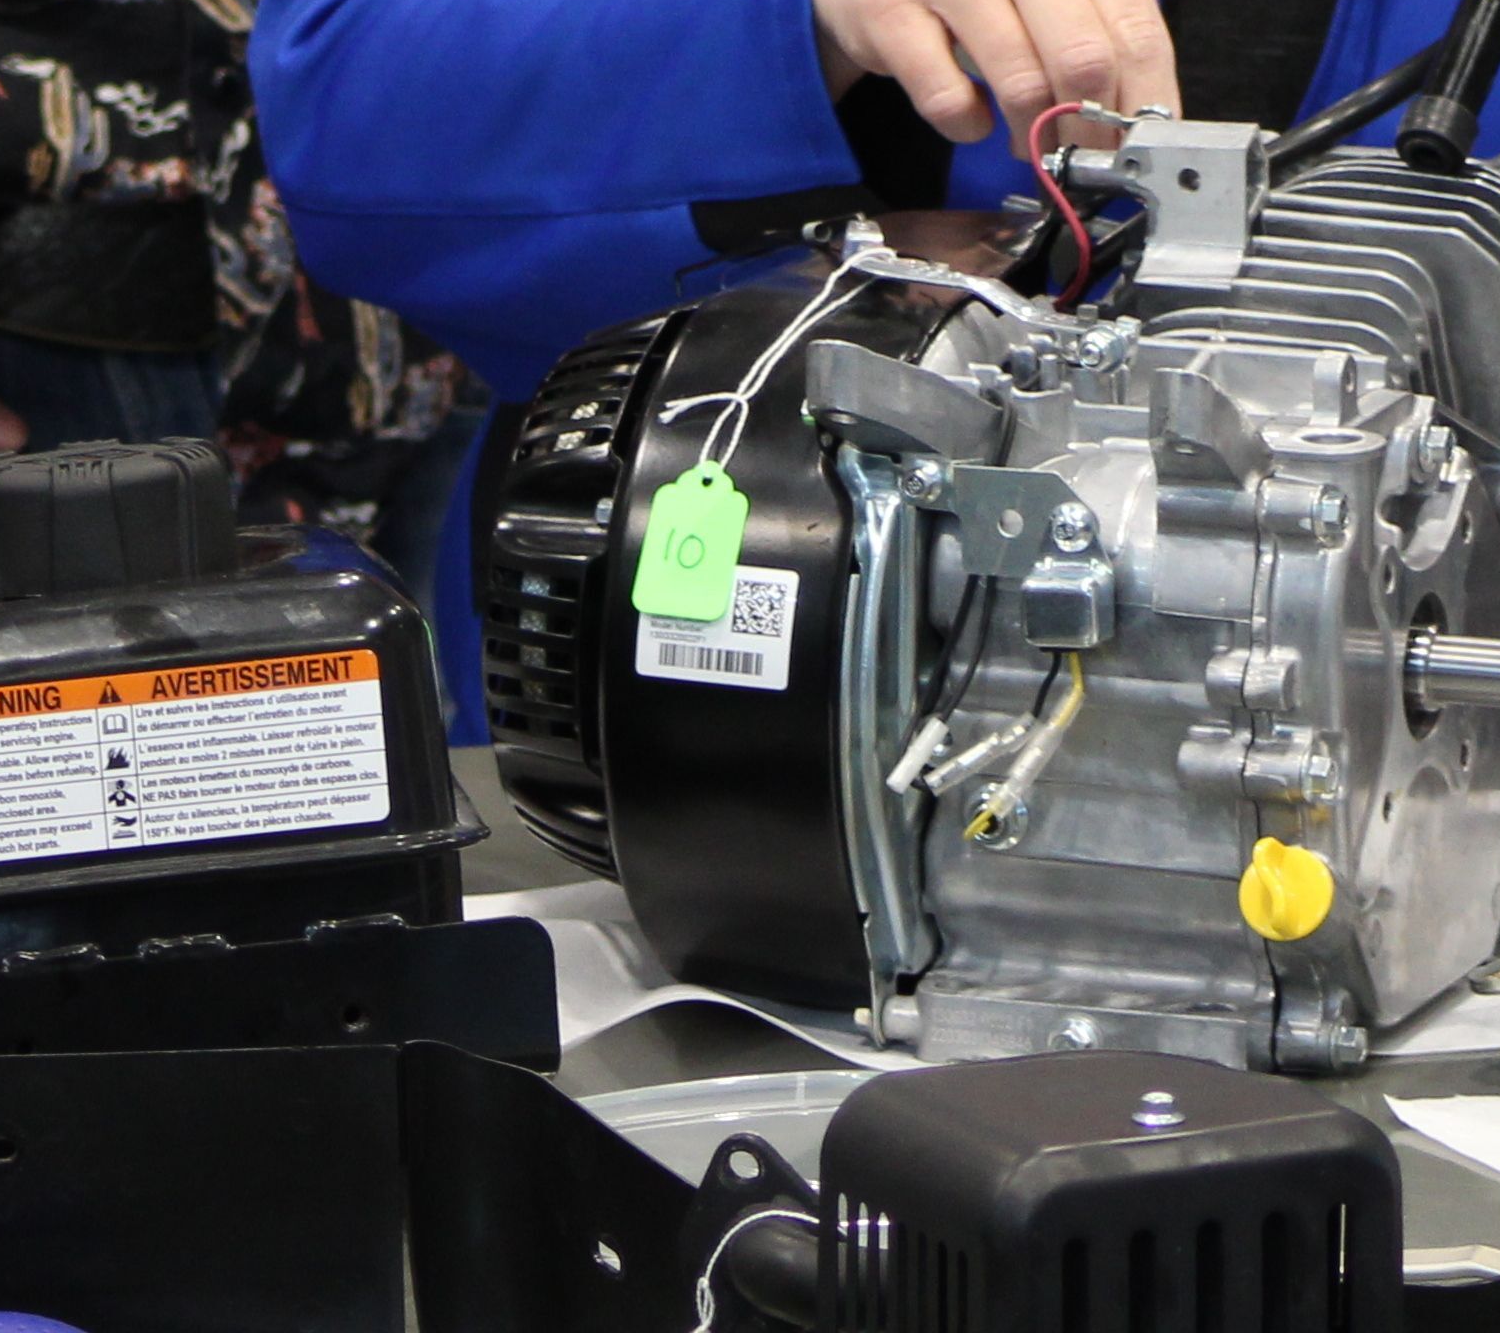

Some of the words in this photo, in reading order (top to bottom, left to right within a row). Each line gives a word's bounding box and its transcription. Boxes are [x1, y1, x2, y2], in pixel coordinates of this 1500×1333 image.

[664, 528, 705, 569] 10
[151, 656, 353, 699] AVERTISSEMENT
[136, 708, 152, 717] Lire
[155, 706, 164, 716] et
[166, 704, 193, 714] suivre
[196, 703, 209, 711] les
[212, 698, 264, 710] instructions
[322, 688, 346, 699] avant
[138, 723, 148, 732] de
[207, 714, 246, 725] effectuer
[297, 707, 307, 716] du
[1, 735, 41, 747] servicing
[187, 739, 200, 748] est
[262, 731, 294, 741] Laisser
[297, 726, 332, 738] refroidir
[335, 725, 342, 734] le
[345, 723, 376, 733] moteur
[26, 755, 49, 765] Allow
[53, 752, 82, 763] engine
[85, 750, 93, 759] to
[140, 756, 176, 770] pendant
[179, 756, 189, 764] au
[192, 752, 219, 762] moins
[222, 751, 227, 759] 2
[230, 748, 265, 759] minutes
[268, 744, 292, 755] avant
[295, 743, 305, 752] de
[308, 742, 328, 751] faire
[330, 740, 338, 749] le
[26, 769, 54, 780] before
[142, 778, 157, 787] Les
[160, 775, 196, 785] moteurs
[240, 768, 251, 778] du
[253, 764, 299, 776] monoxyde
[302, 762, 312, 771] de
[143, 792, 156, 802] NE
[159, 790, 176, 800] PAS
[179, 788, 198, 798] faire
[201, 786, 232, 796] tourner
[235, 784, 243, 793] le
[245, 781, 276, 792] moteur
[279, 779, 300, 788] dans
[303, 777, 318, 786] des
[321, 774, 357, 785] espaces
[145, 813, 174, 823] Autour
[177, 810, 189, 820] du
[241, 805, 249, 814] la
[308, 796, 328, 809] peut
[40, 826, 58, 835] may
[61, 820, 92, 832] exceed
[176, 826, 186, 835] Ne
[189, 825, 205, 836] pas
[208, 820, 242, 831] toucher
[245, 819, 260, 828] des
[19, 841, 33, 851] hot
